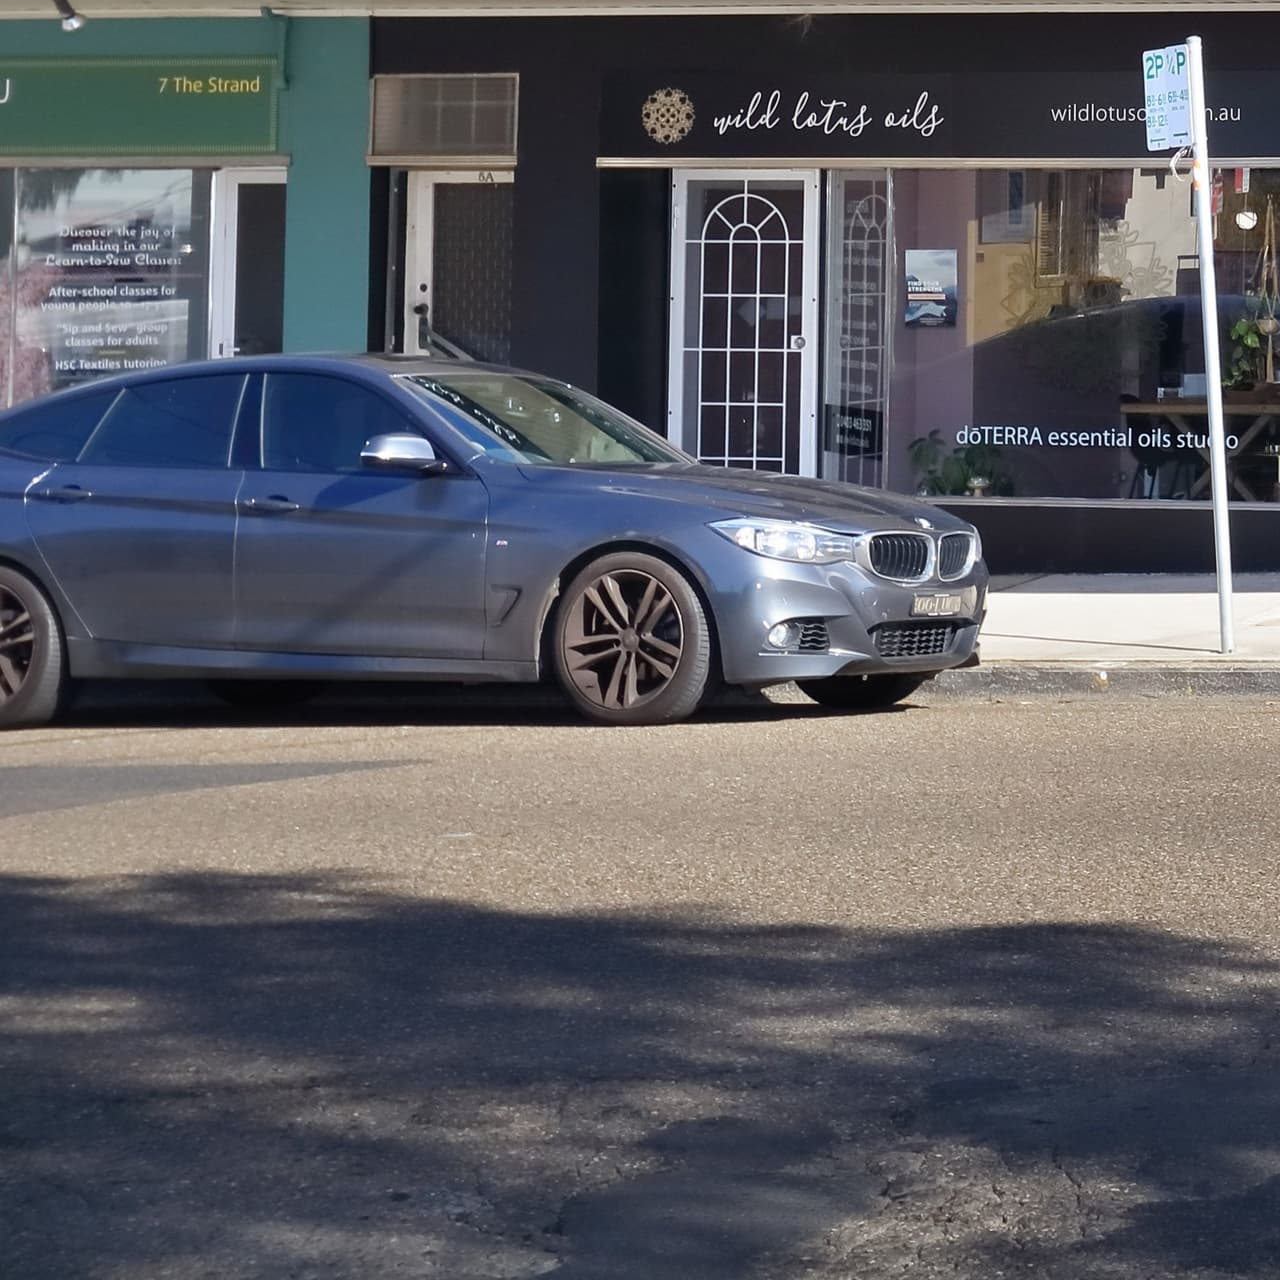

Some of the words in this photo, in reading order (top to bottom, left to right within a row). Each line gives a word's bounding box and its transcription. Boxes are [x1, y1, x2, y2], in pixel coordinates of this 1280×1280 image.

[1145, 53, 1164, 80] 2P
[159, 78, 169, 93] 7
[174, 76, 203, 93] The
[208, 75, 261, 94] Strand
[713, 89, 781, 136] wild
[791, 91, 874, 137] lotus
[884, 91, 945, 137] oils
[59, 226, 113, 238] Discover
[116, 224, 136, 237] the
[141, 226, 159, 239] joy
[163, 226, 177, 239] of
[72, 240, 120, 254] making
[124, 240, 136, 252] in
[139, 243, 161, 252] our
[45, 253, 131, 266] Learn-to-Sew
[49, 285, 117, 298] After-school
[119, 285, 158, 297] classes
[161, 285, 177, 296] for
[41, 301, 77, 313] young
[82, 322, 102, 333] and
[65, 336, 104, 347] classes
[107, 336, 123, 347] for
[125, 335, 159, 346] adults
[55, 359, 76, 371] HSC
[79, 358, 121, 370] Textiles
[1048, 427, 1133, 448] essential
[1138, 428, 1171, 449] oils
[1176, 430, 1239, 450] stuo
